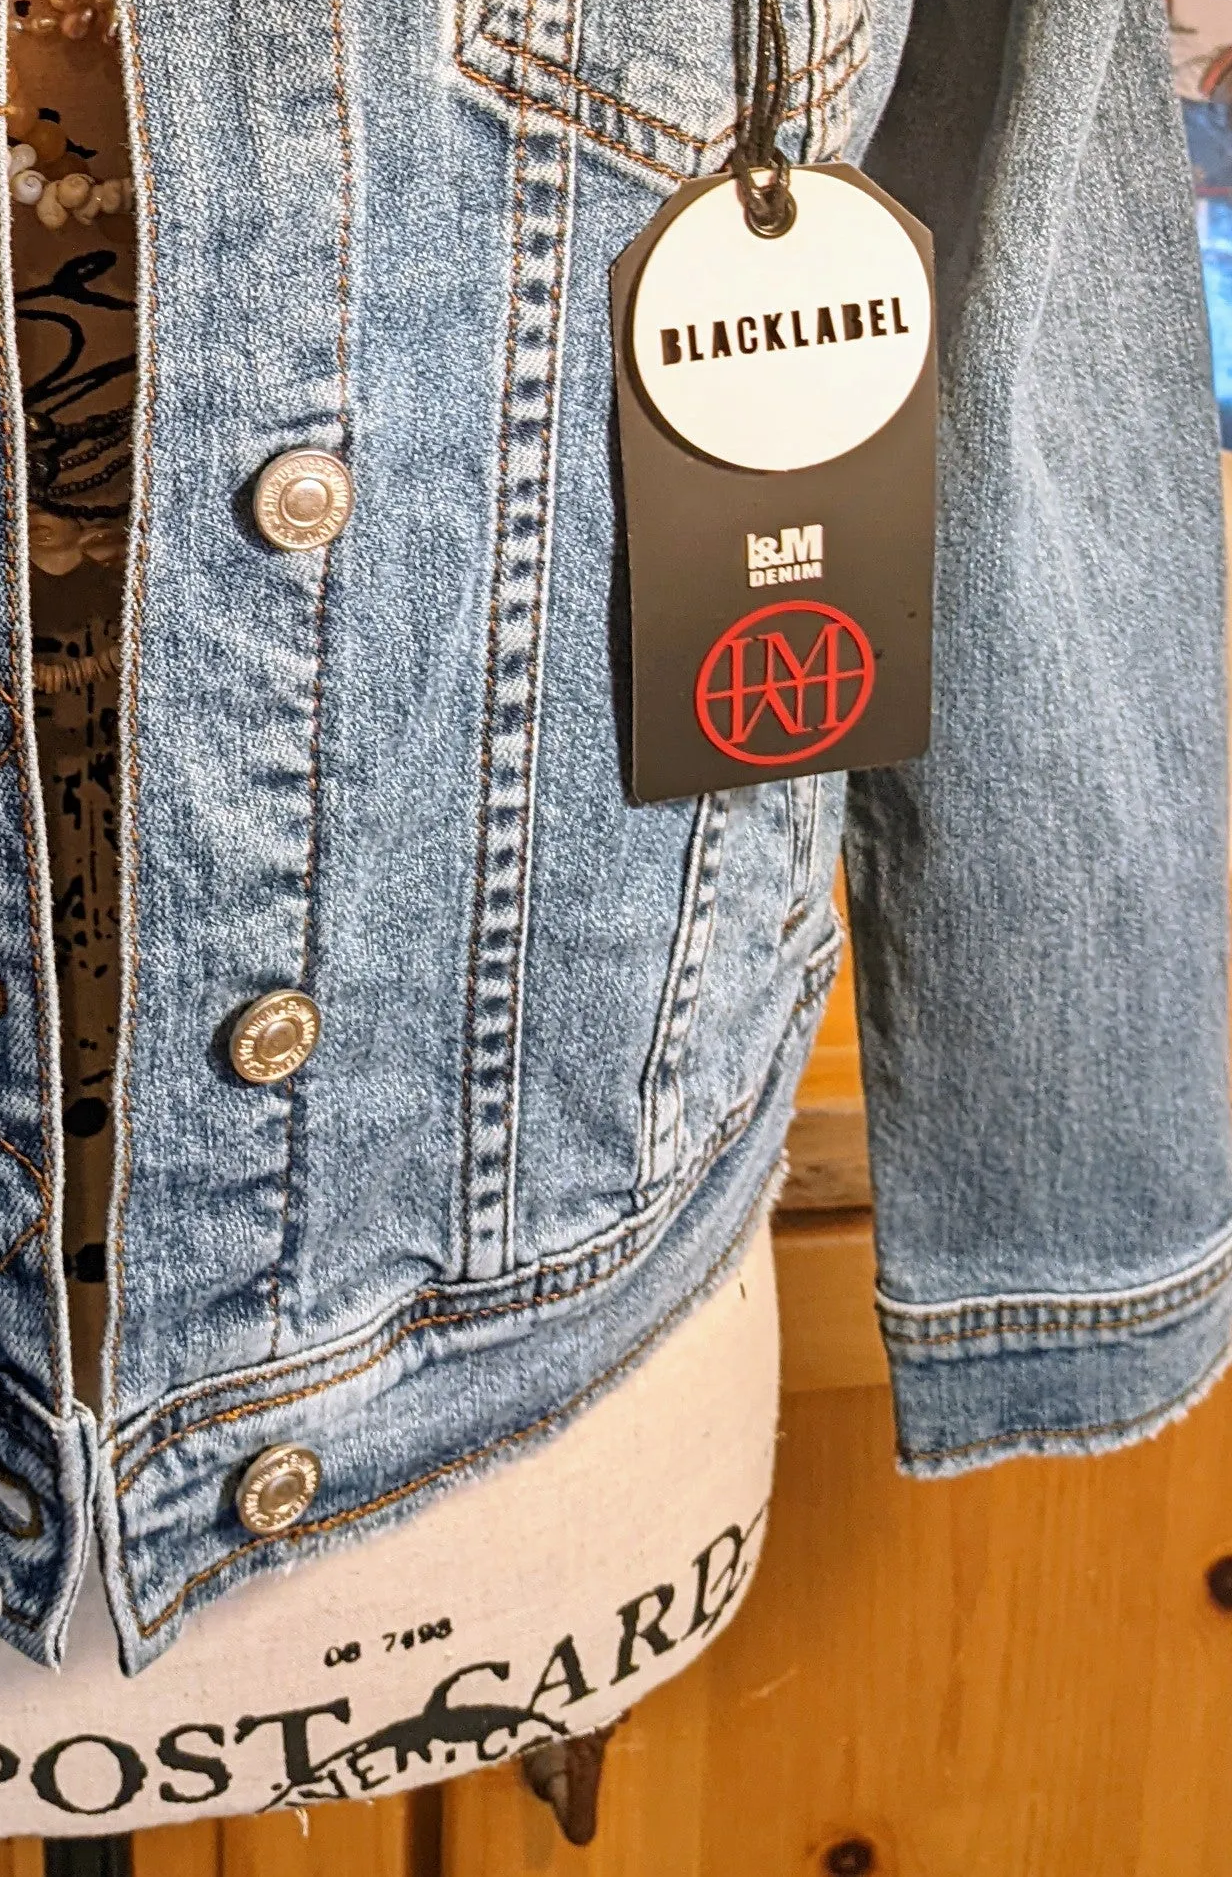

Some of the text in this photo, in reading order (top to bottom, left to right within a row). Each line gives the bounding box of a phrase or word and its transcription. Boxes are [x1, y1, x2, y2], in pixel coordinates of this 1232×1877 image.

[660, 296, 910, 366] BLACKLABEL
[749, 561, 824, 589] DENIM
[422, 1523, 745, 1723] CARD
